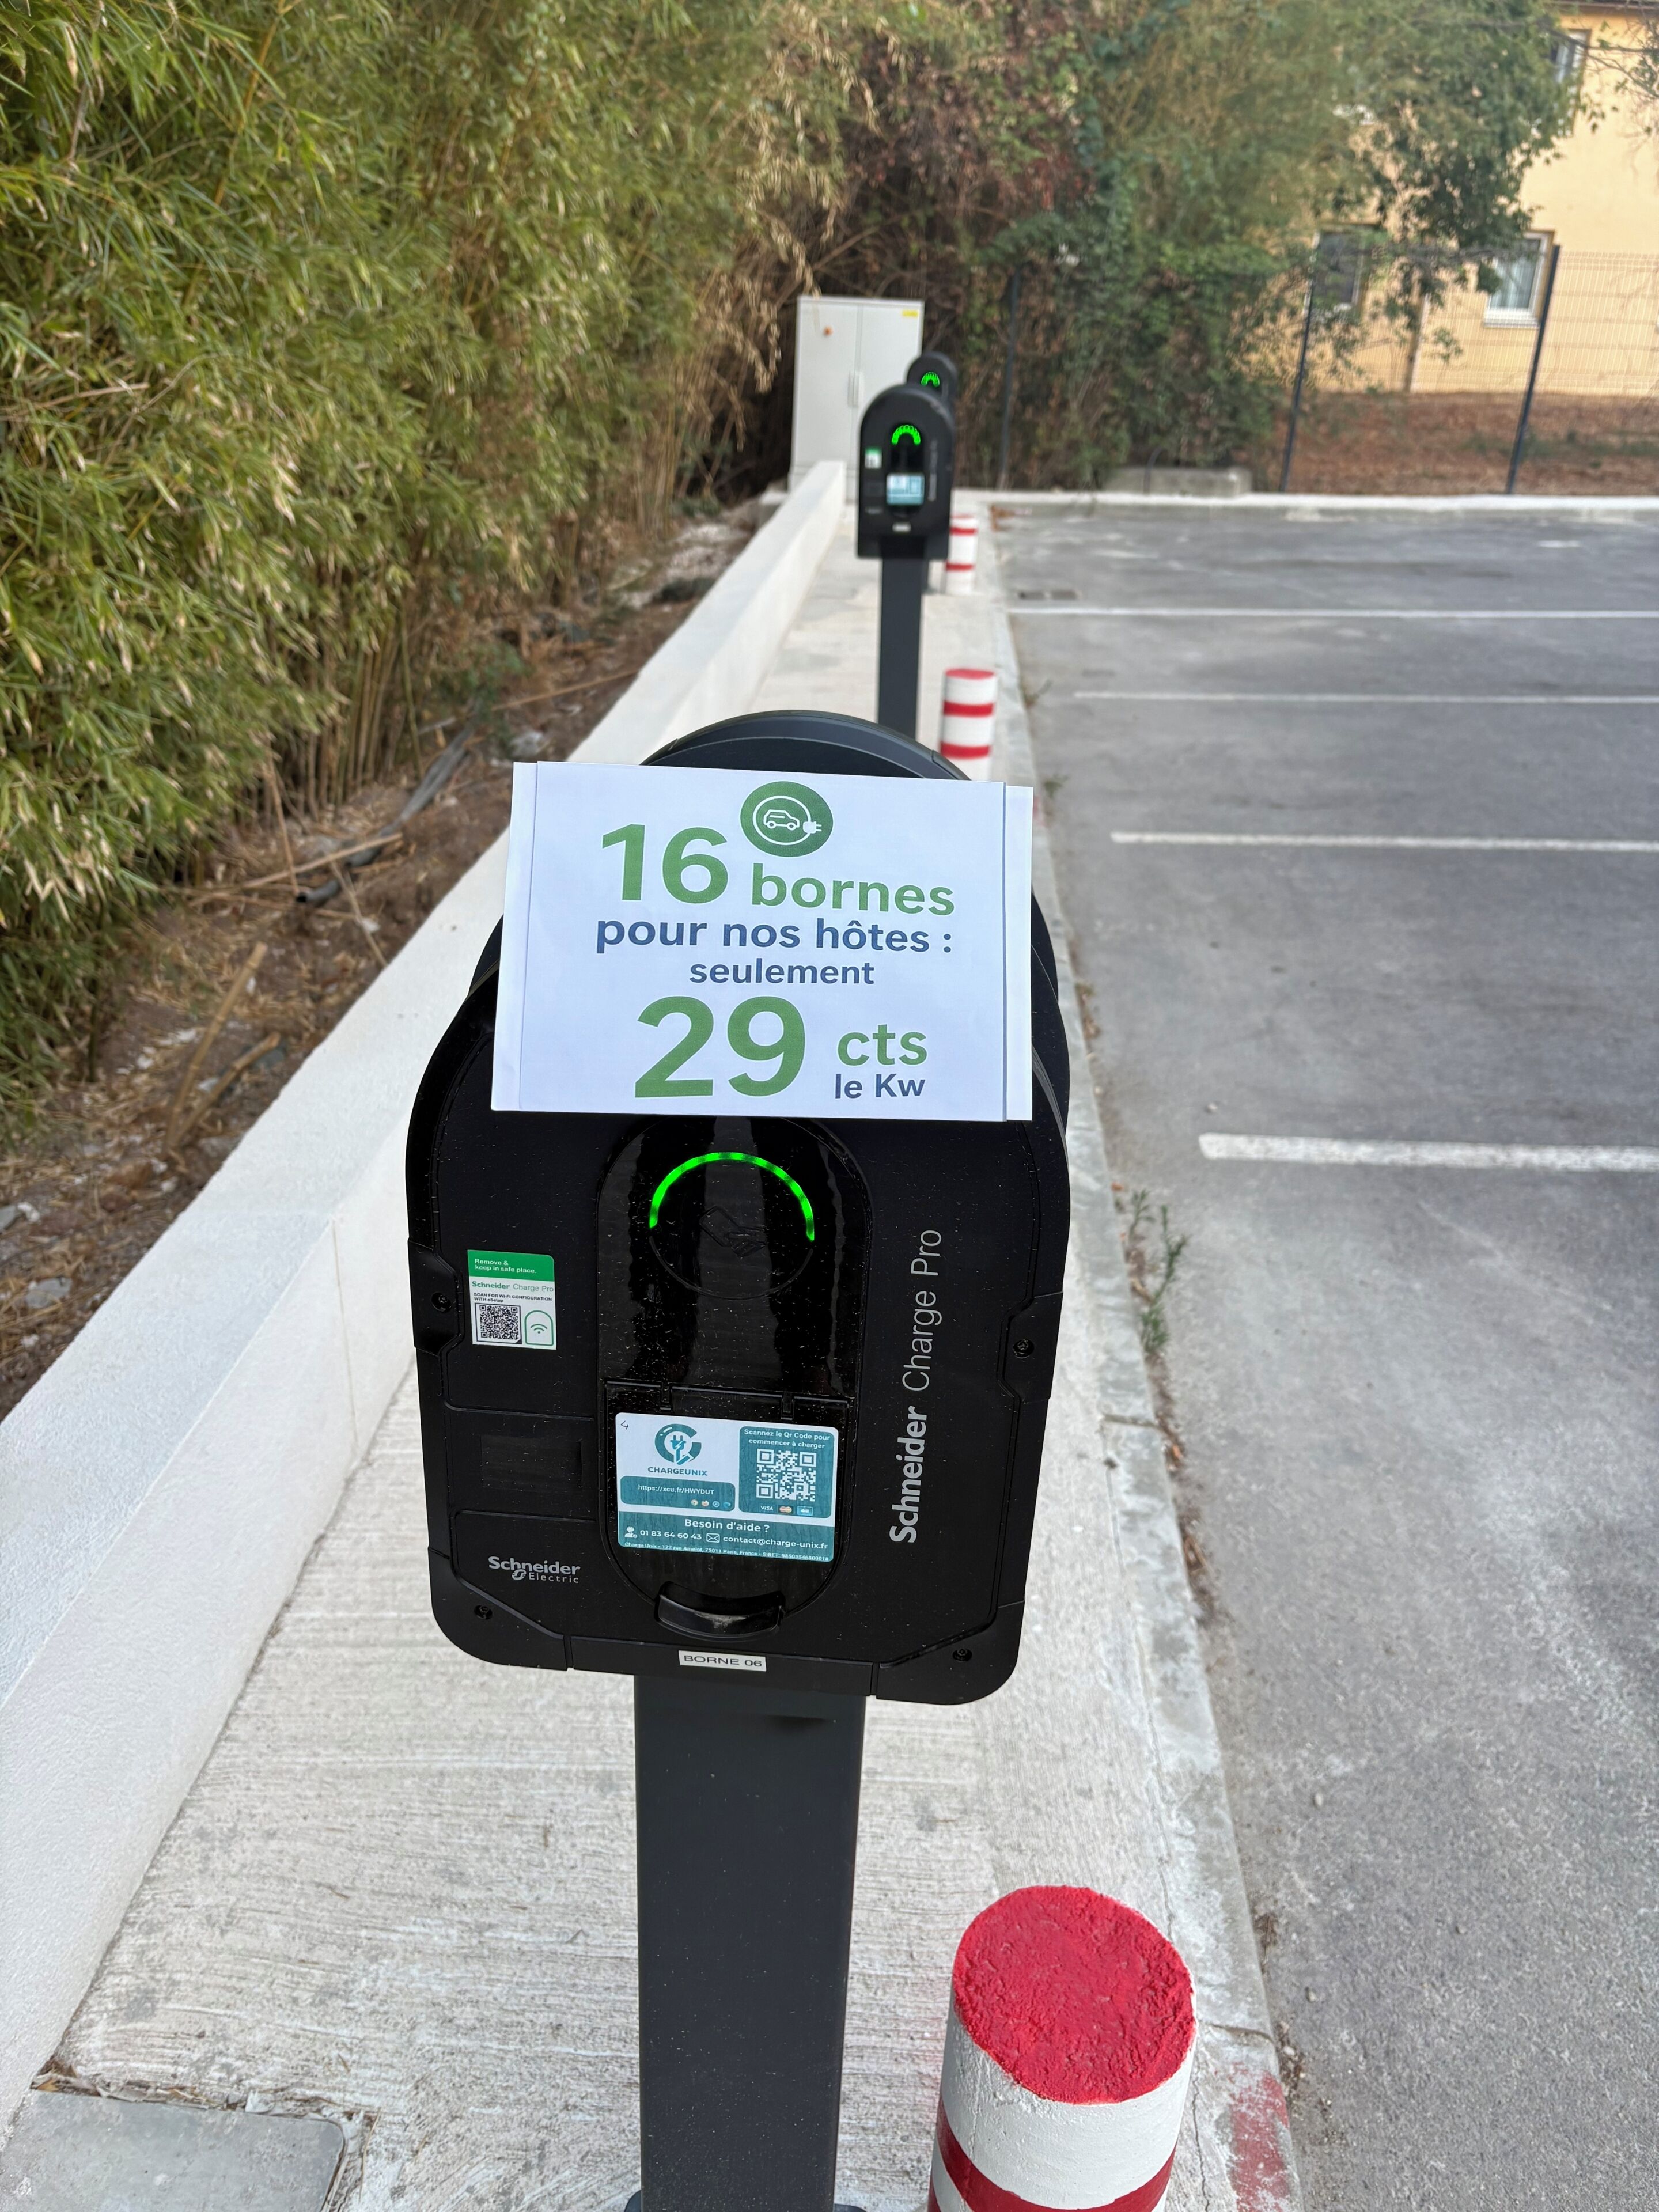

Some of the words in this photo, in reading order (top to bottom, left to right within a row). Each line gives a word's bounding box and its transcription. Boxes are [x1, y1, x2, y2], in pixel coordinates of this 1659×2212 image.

[601, 824, 729, 904] 16
[751, 863, 955, 916] bornes
[597, 918, 707, 953] pour
[723, 921, 801, 948] nos
[816, 918, 929, 952] hôtes
[690, 959, 874, 984] seulement
[634, 996, 805, 1099] 29
[836, 1023, 927, 1066] cts
[835, 1073, 863, 1099] le
[875, 1074, 926, 1098] Kw
[911, 1230, 942, 1276] Pro
[472, 1281, 510, 1289] Schneider
[513, 1283, 539, 1292] Charge
[902, 1290, 942, 1391] Charge
[744, 1429, 774, 1437] Scannez
[813, 1435, 831, 1443] pour
[798, 1441, 825, 1449] charger
[647, 1467, 709, 1476] CHARGEUNIX
[889, 1406, 927, 1544] Schneider
[638, 1484, 715, 1495] https://xcu.fr/HWYDUT
[684, 1518, 723, 1529] Besoin
[764, 1524, 770, 1532] ?
[723, 1536, 828, 1549] contact@charge-unix.fr
[488, 1556, 581, 1575] Schneider
[529, 1572, 579, 1583] Electric
[684, 1655, 740, 1665] BORNE
